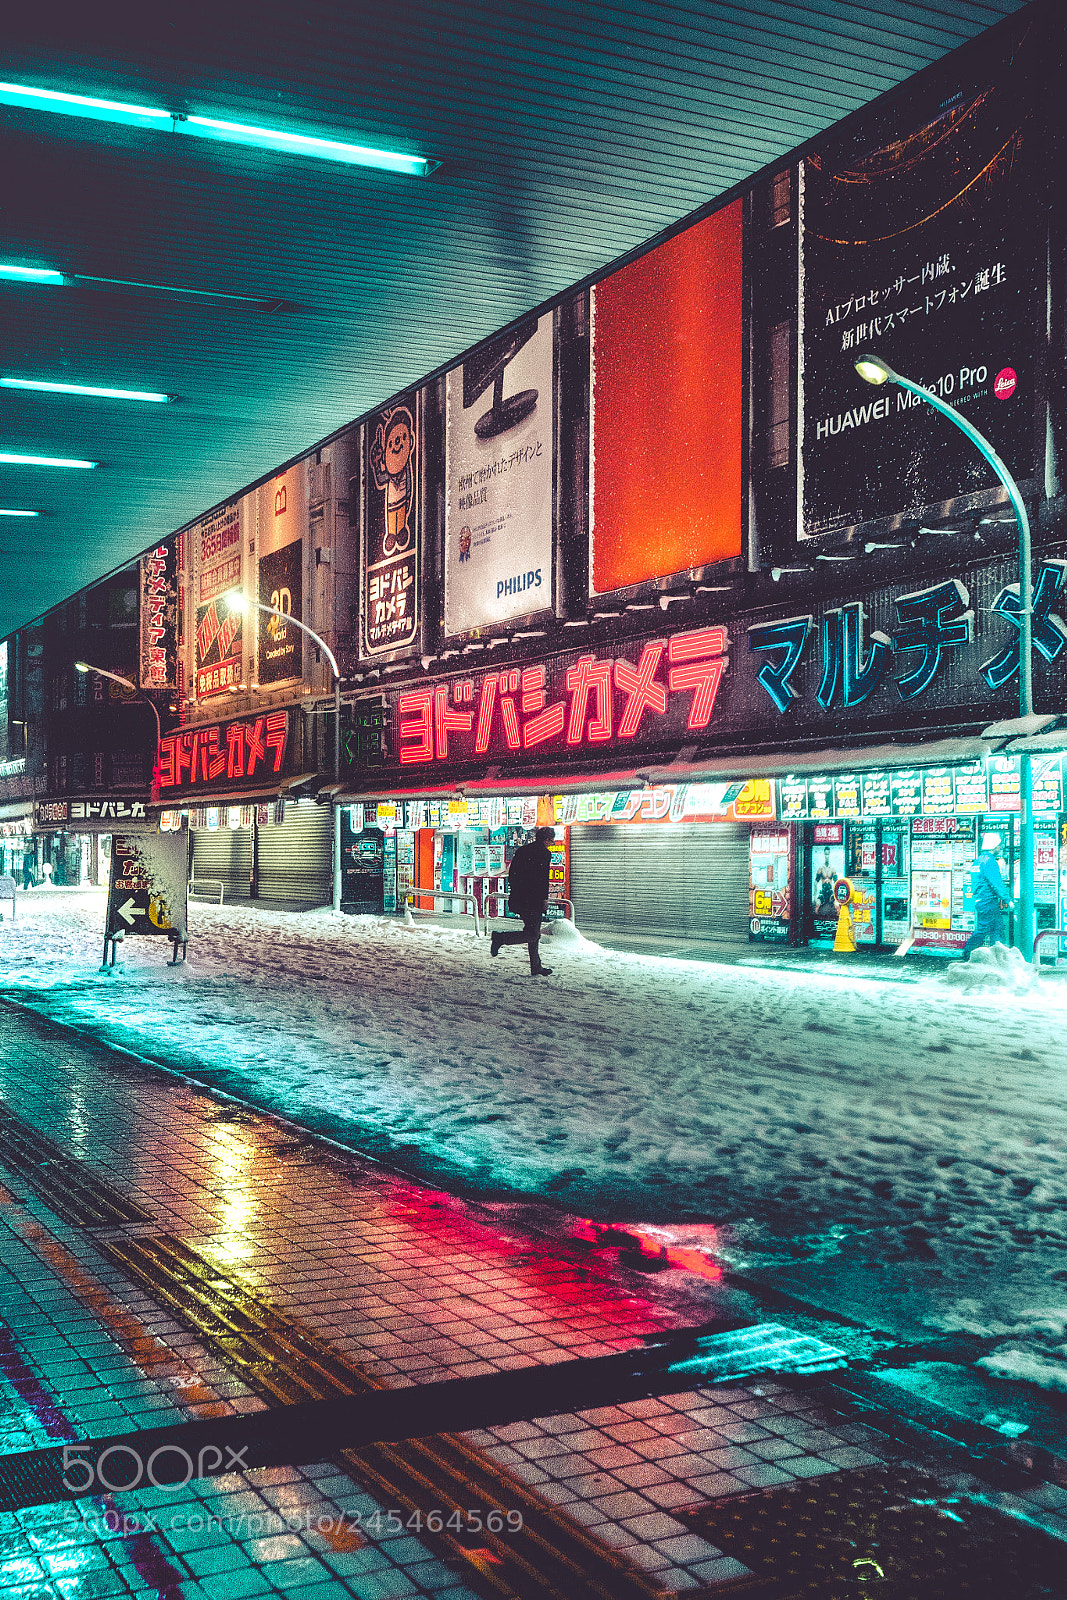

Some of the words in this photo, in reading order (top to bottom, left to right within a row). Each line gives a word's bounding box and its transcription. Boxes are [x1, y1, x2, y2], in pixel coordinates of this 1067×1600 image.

[840, 262, 1007, 353] 新世代スマートフォン誕生
[816, 397, 890, 440] HUAWEI
[959, 366, 988, 390] Pro
[995, 378, 1016, 392] Leica
[369, 565, 413, 602] ヨドバシ
[496, 568, 542, 599] PHILIPS
[270, 587, 292, 625] 3D
[375, 592, 407, 625] カメラ
[399, 627, 729, 764] ヨドバシカメラ
[160, 711, 289, 789] ヨドバシカメラ
[71, 801, 146, 818] ヨドバシカ
[912, 817, 957, 834] 全館案内
